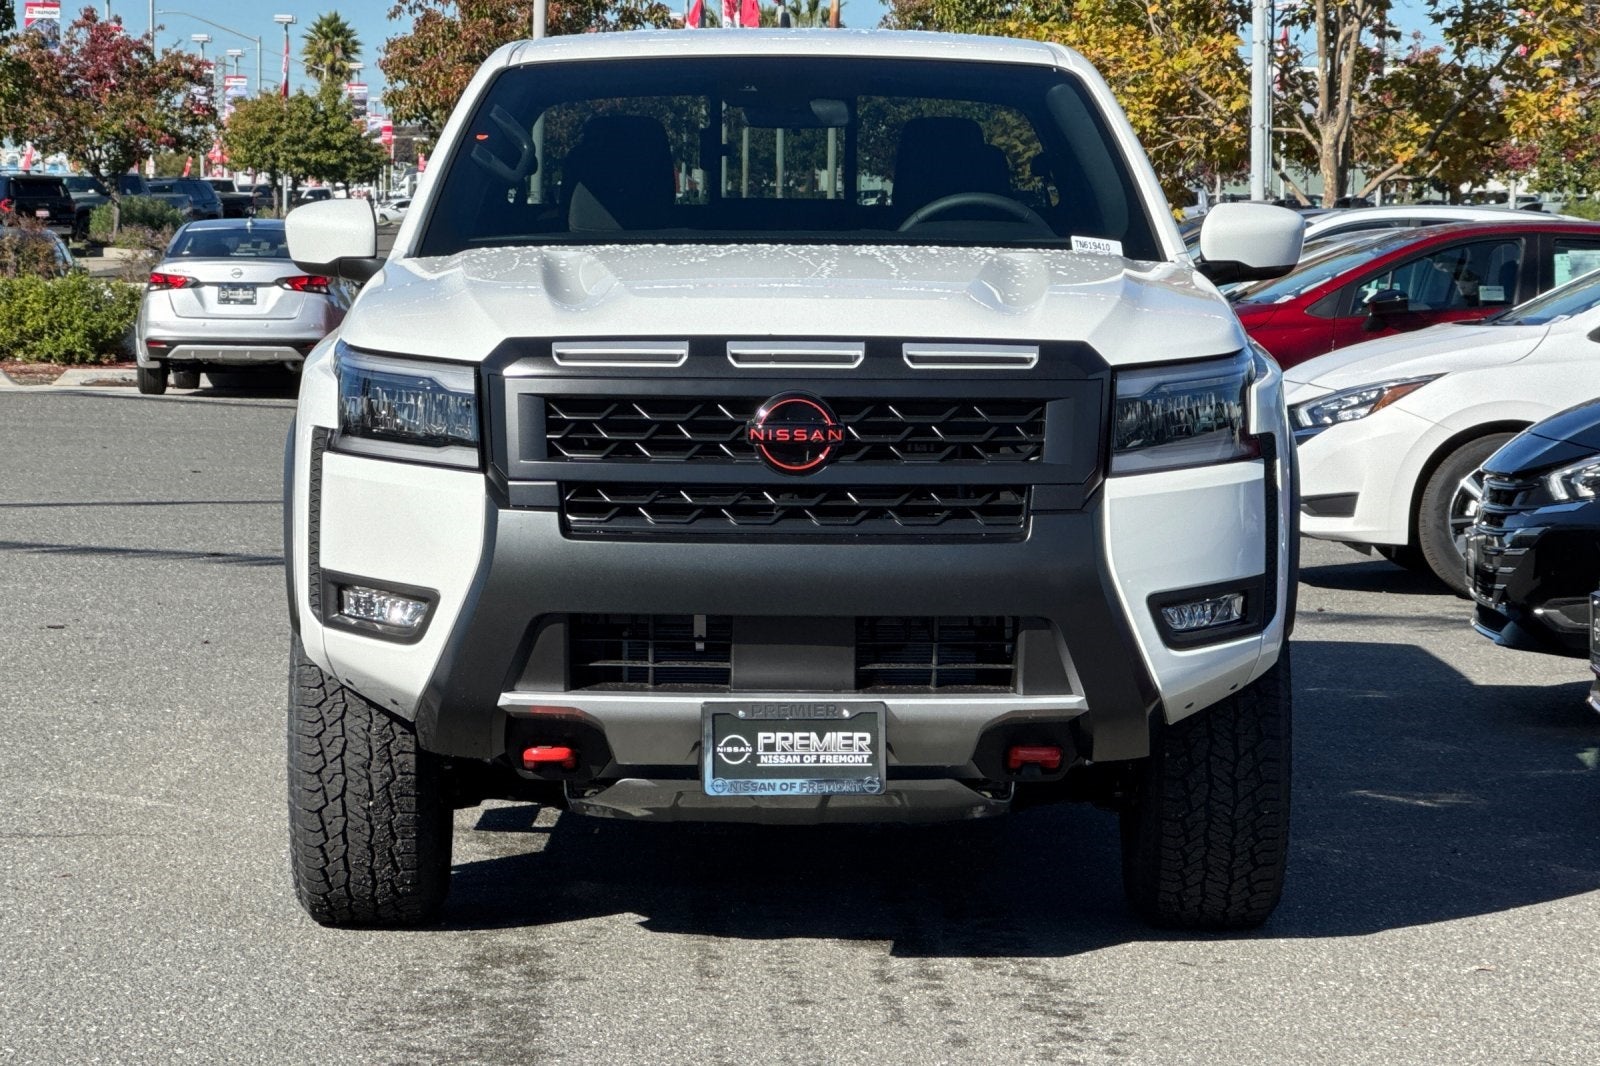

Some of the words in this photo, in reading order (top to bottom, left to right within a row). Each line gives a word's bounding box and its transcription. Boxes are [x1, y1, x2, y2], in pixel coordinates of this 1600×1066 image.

[1075, 240, 1111, 252] TN619410
[750, 429, 842, 441] NISSAN
[751, 704, 838, 718] PREMIER
[757, 732, 871, 752] PREMIER
[760, 755, 800, 764] NISSAN
[803, 755, 817, 764] OF
[819, 755, 869, 764] FREMONT
[729, 782, 776, 792] NISSAN
[780, 782, 797, 791] OF
